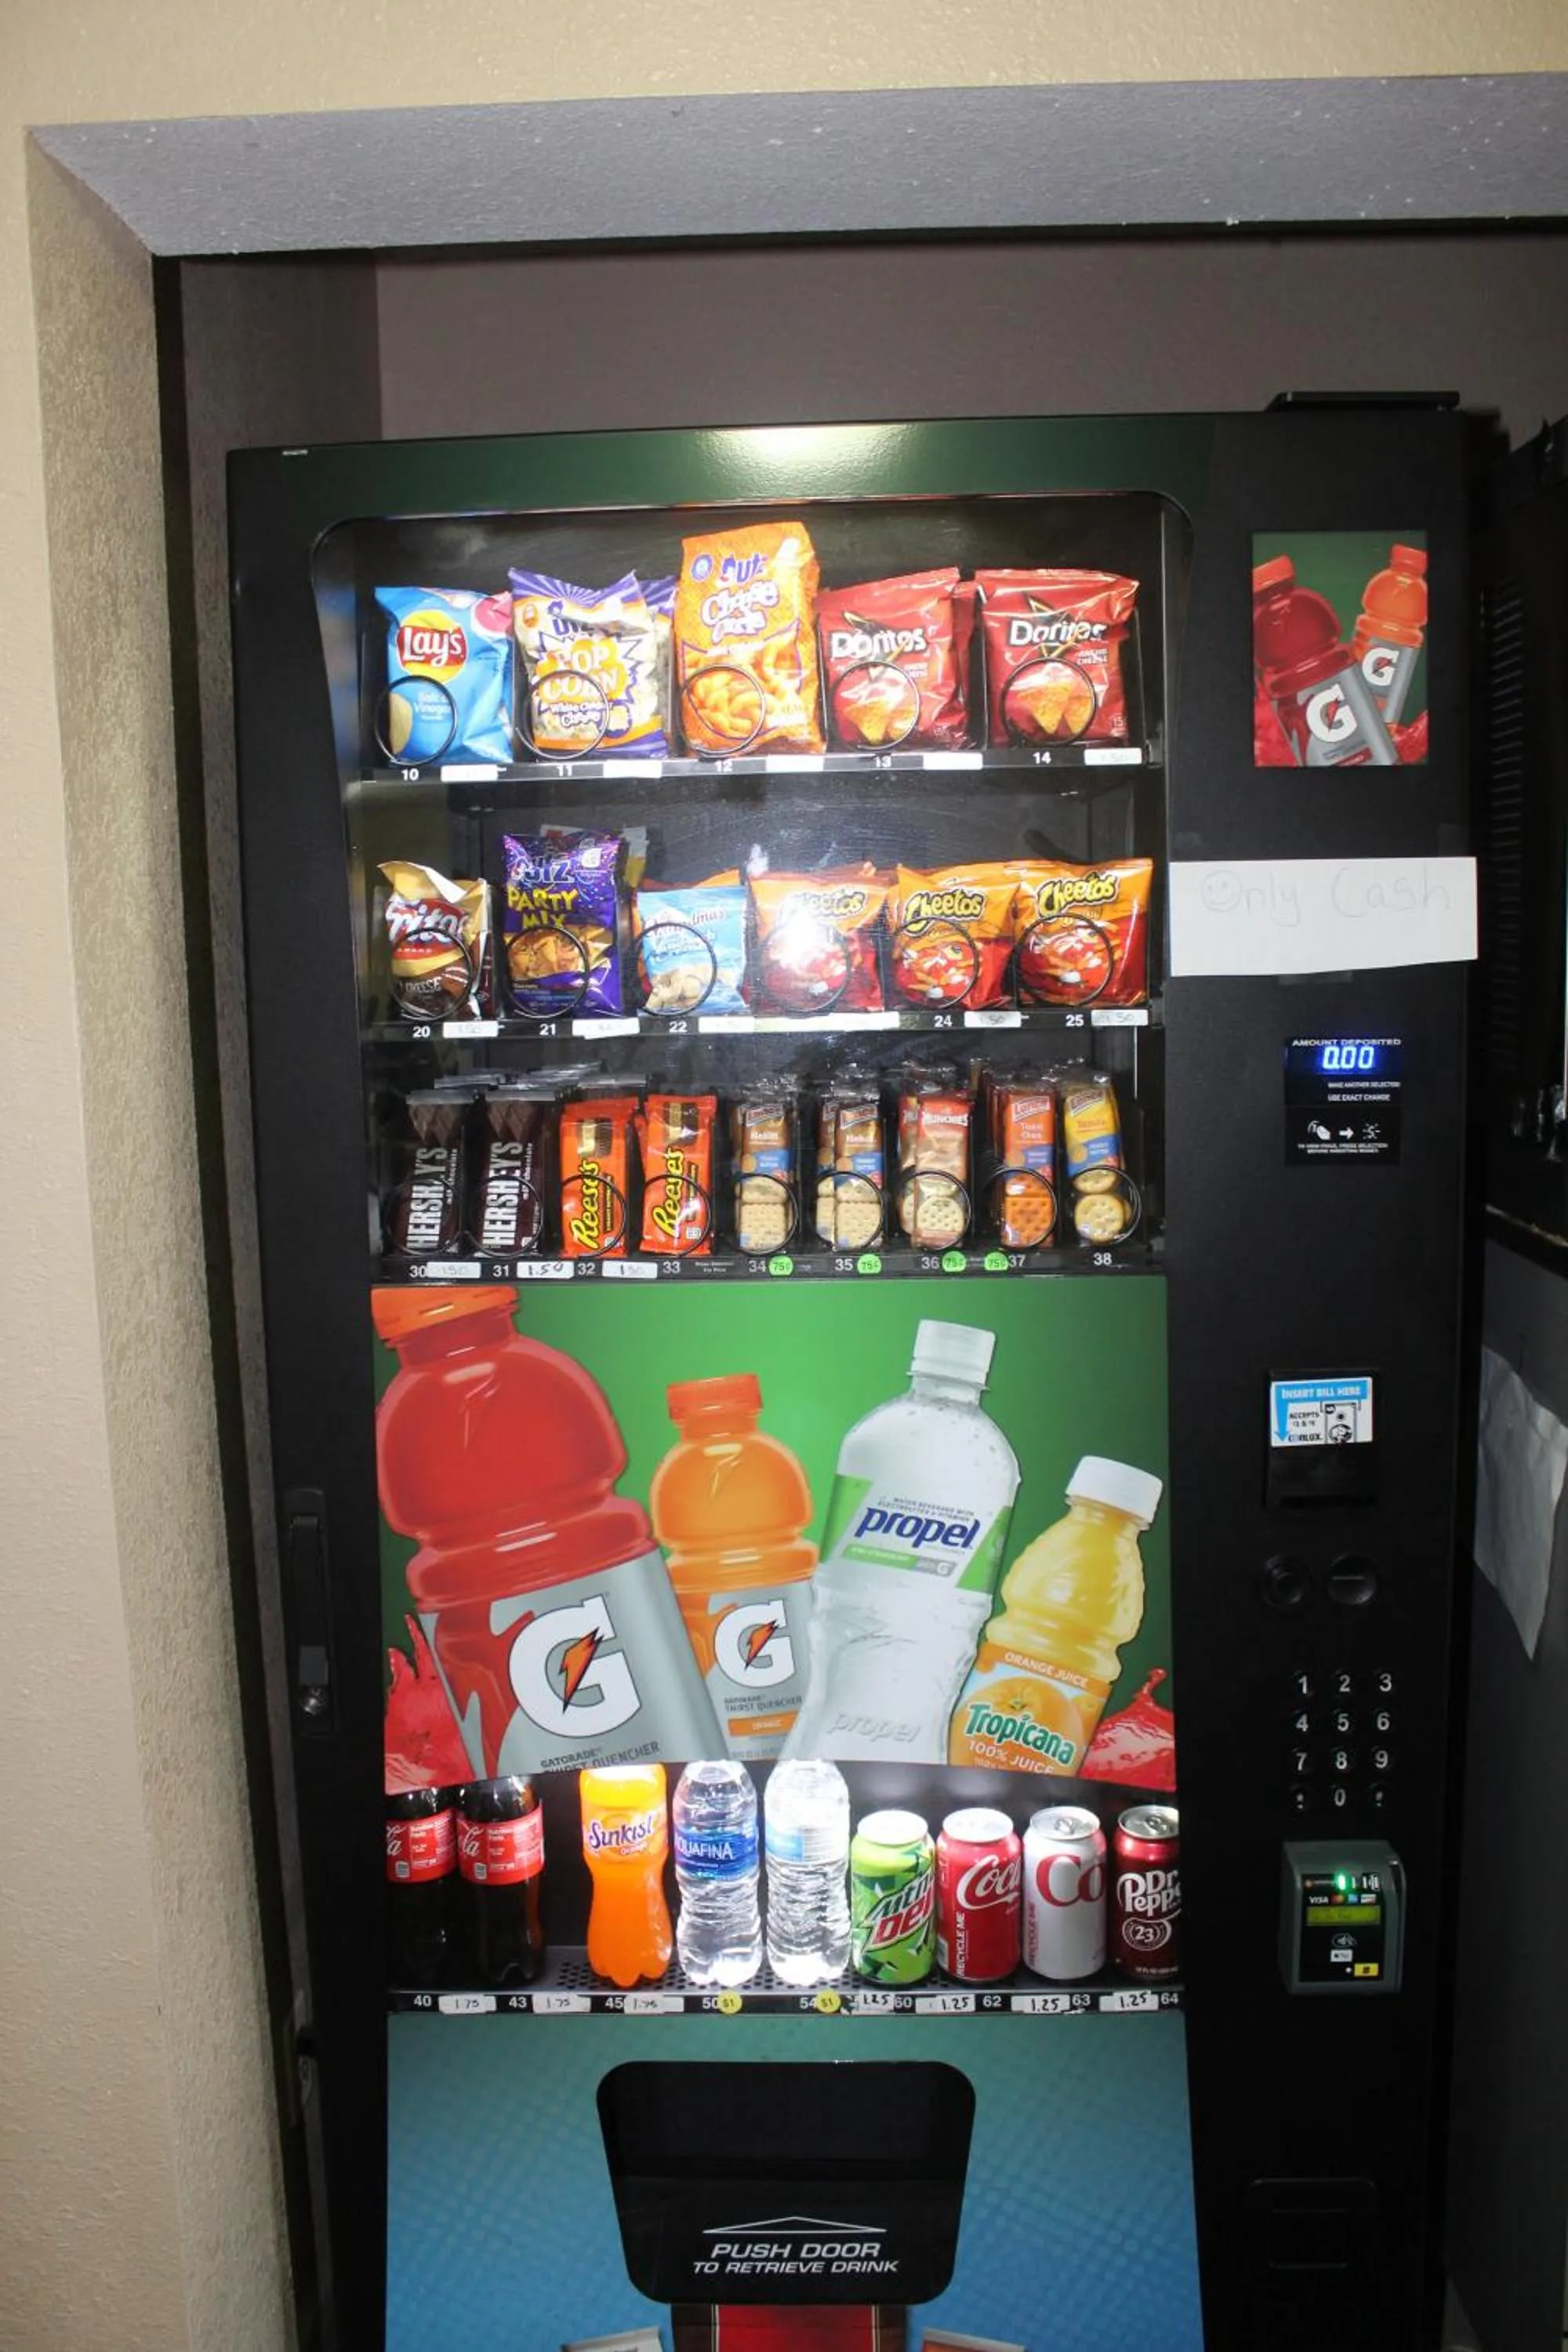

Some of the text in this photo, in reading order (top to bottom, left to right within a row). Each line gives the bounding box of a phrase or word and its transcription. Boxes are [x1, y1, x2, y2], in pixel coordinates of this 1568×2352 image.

[1009, 619, 1108, 645] Doritos
[402, 626, 463, 667] Lay's
[832, 628, 927, 659] Doritos
[1362, 647, 1400, 686] G
[1306, 683, 1358, 742] G
[716, 760, 733, 771] 12
[875, 756, 891, 768] 13
[1033, 752, 1051, 764] 14
[401, 769, 419, 781] 10
[558, 765, 573, 776] 11
[507, 887, 578, 912] PARTY
[1038, 871, 1118, 918] Cheetos
[1201, 866, 1451, 927] Only Cash
[523, 911, 567, 929] MIX
[903, 889, 985, 935] Cheetos
[539, 1024, 557, 1035] 21
[669, 1022, 688, 1033] 22
[935, 1016, 952, 1027] 24
[1066, 1015, 1083, 1026] 25
[412, 1026, 430, 1038] 20
[406, 1147, 448, 1249] HERSHY'S
[482, 1142, 523, 1246] HERSHEY'S
[652, 1147, 685, 1239] Reese's
[570, 1157, 601, 1250] Reese's
[662, 1261, 681, 1274] 33
[749, 1260, 767, 1272] 34
[835, 1258, 853, 1271] 35
[921, 1257, 939, 1269] 36
[1008, 1255, 1025, 1268] 37
[1094, 1253, 1112, 1265] 38
[409, 1265, 427, 1277] 30
[492, 1262, 564, 1276] 31 1.50
[577, 1262, 596, 1276] 32
[854, 1507, 981, 1548] propel
[714, 1599, 798, 1688] G
[508, 1594, 643, 1739] G
[1004, 1651, 1089, 1689] ORANGE JUICE
[1298, 1675, 1308, 1693] 1
[1339, 1675, 1351, 1692] 2
[1379, 1674, 1392, 1692] 3
[829, 1713, 923, 1744] propel
[1296, 1714, 1308, 1732] 4
[1338, 1713, 1349, 1731] 5
[1377, 1712, 1390, 1730] 6
[965, 1703, 1076, 1767] Tropicana
[540, 1749, 598, 1768] GATORADE
[591, 1740, 660, 1769] QUENCHER
[968, 1740, 1008, 1762] 100%
[1010, 1755, 1054, 1774] JUICE
[1295, 1752, 1307, 1771] 7
[1336, 1751, 1348, 1769] 8
[1375, 1750, 1388, 1769] 9
[1334, 1788, 1346, 1806] 0
[589, 1814, 654, 1849] Sunkist
[1036, 1854, 1105, 1907] Co
[1116, 1872, 1181, 1917] Pepp
[1134, 1926, 1155, 1944] 23
[956, 1912, 965, 1977] RECYCLE ME
[413, 1994, 432, 2007] 40
[509, 1996, 528, 2008] 43
[604, 1997, 623, 2009] 45
[862, 1993, 912, 2009] 1.25 60
[941, 1995, 1002, 2010] 1.25 62
[1030, 1994, 1091, 2012] 1.25 63
[1120, 1992, 1178, 2009] 1.25 64
[711, 2242, 880, 2259] PUSH DOOR
[693, 2259, 900, 2274] TO RETRIEVE DRINK
